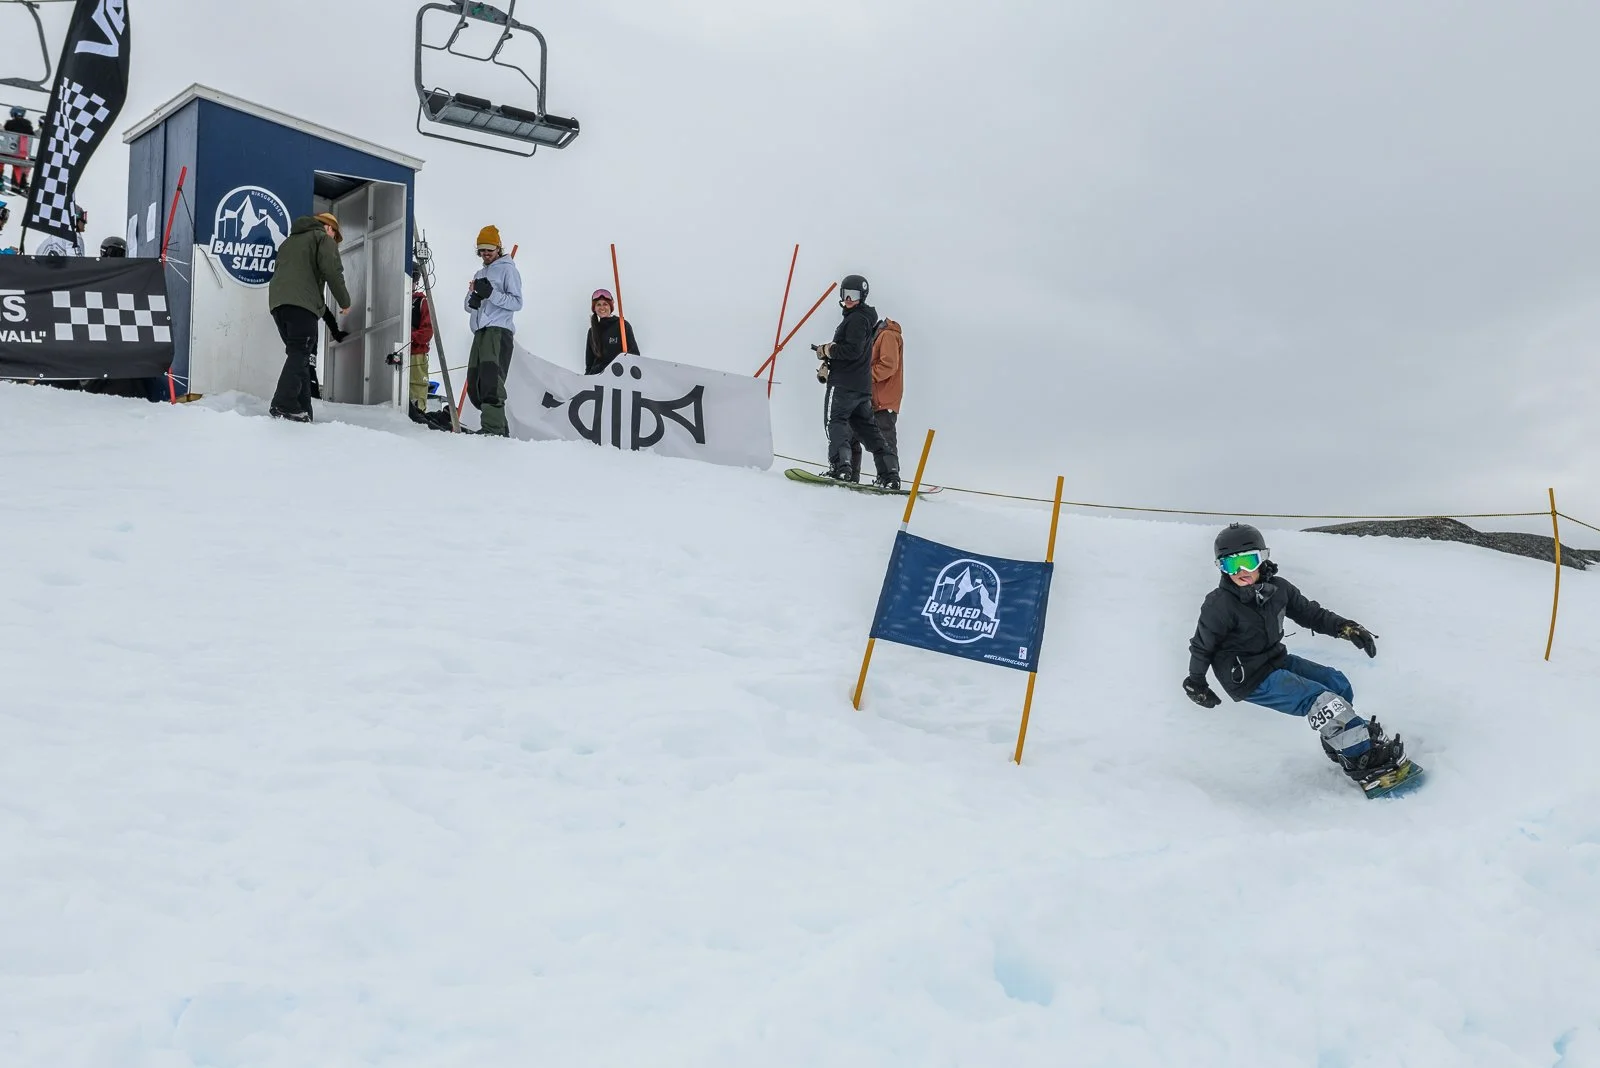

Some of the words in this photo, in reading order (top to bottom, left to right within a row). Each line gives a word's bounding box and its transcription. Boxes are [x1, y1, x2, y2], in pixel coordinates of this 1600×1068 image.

[213, 240, 273, 258] BANKED
[928, 601, 981, 619] BANKED
[941, 616, 994, 634] SLALOM
[1310, 705, 1335, 729] 295
